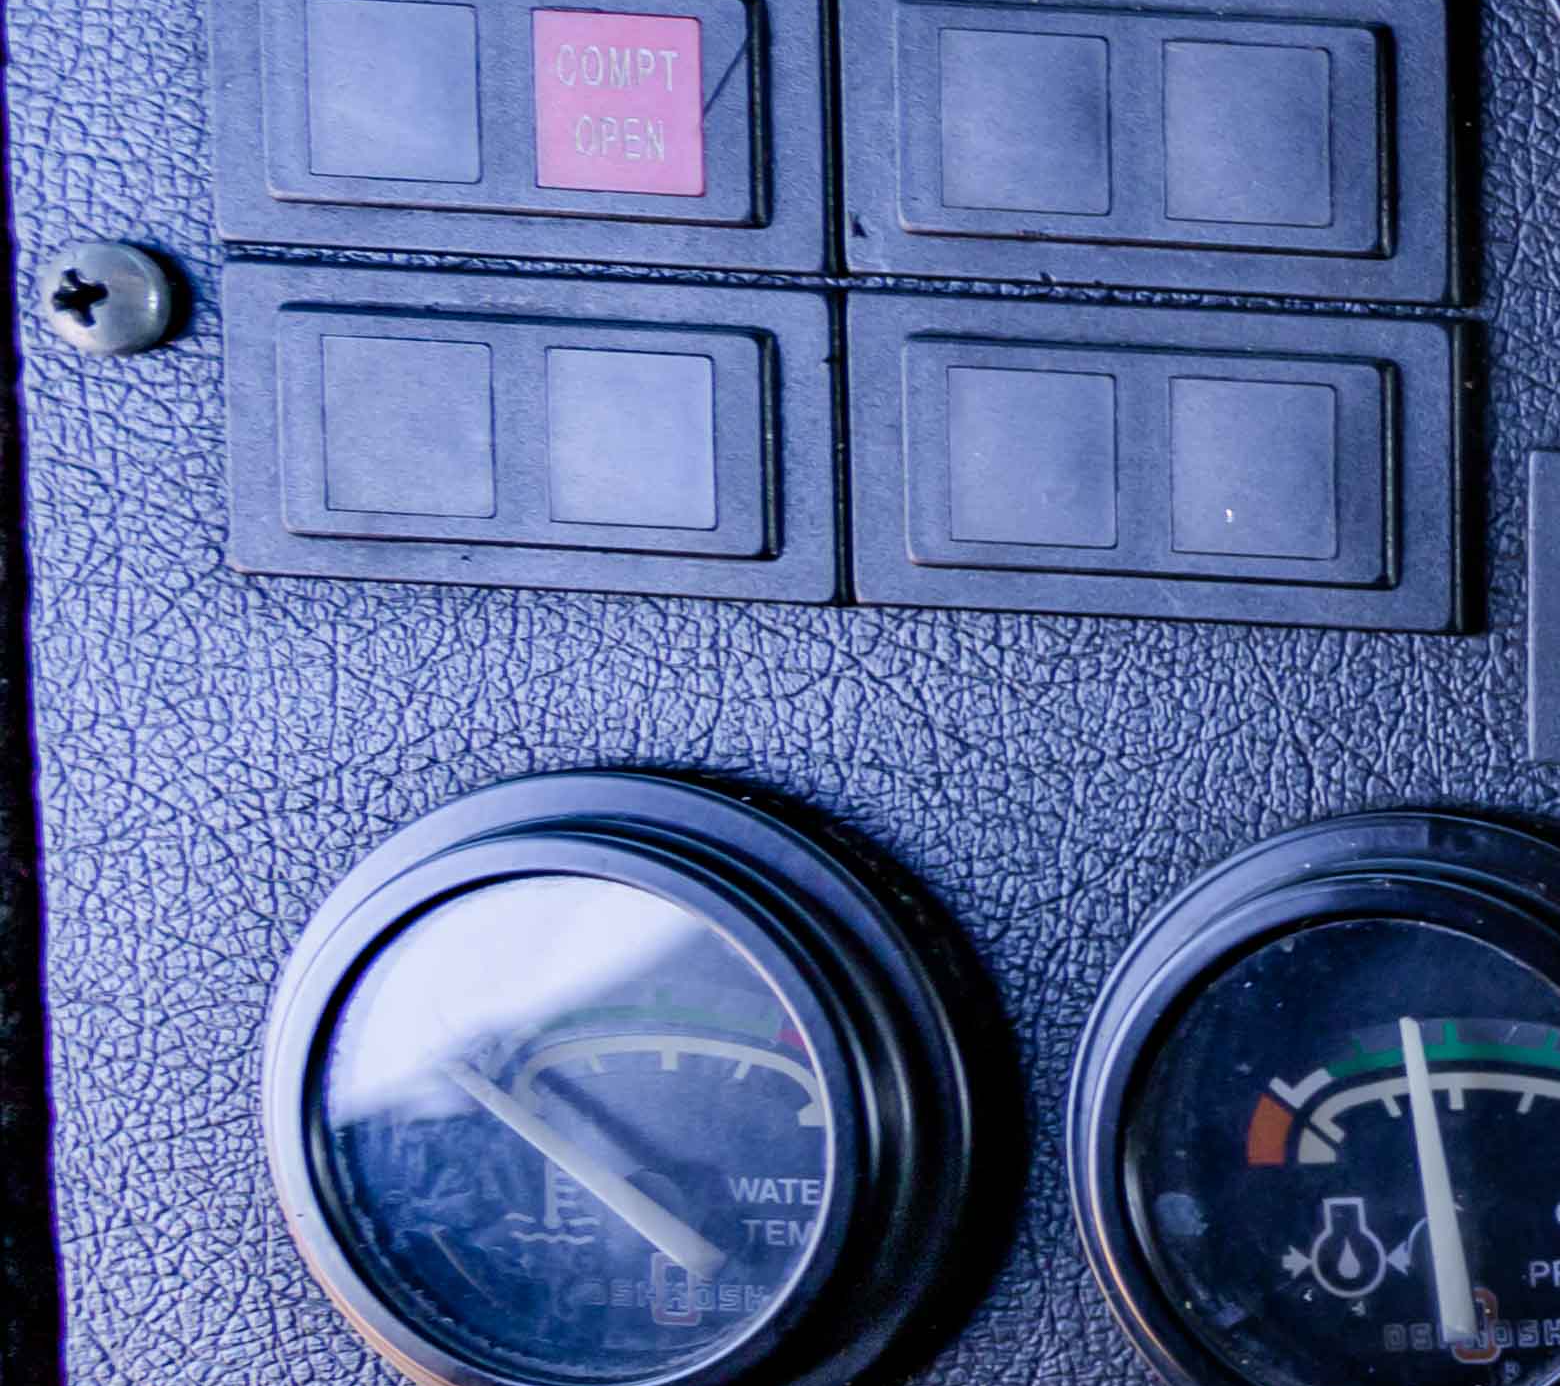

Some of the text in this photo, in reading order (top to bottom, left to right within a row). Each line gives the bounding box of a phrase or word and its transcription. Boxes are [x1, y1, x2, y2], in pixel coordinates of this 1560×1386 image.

[556, 43, 680, 92] COMPT
[575, 115, 665, 162] OPEN
[728, 1175, 822, 1206] WATE
